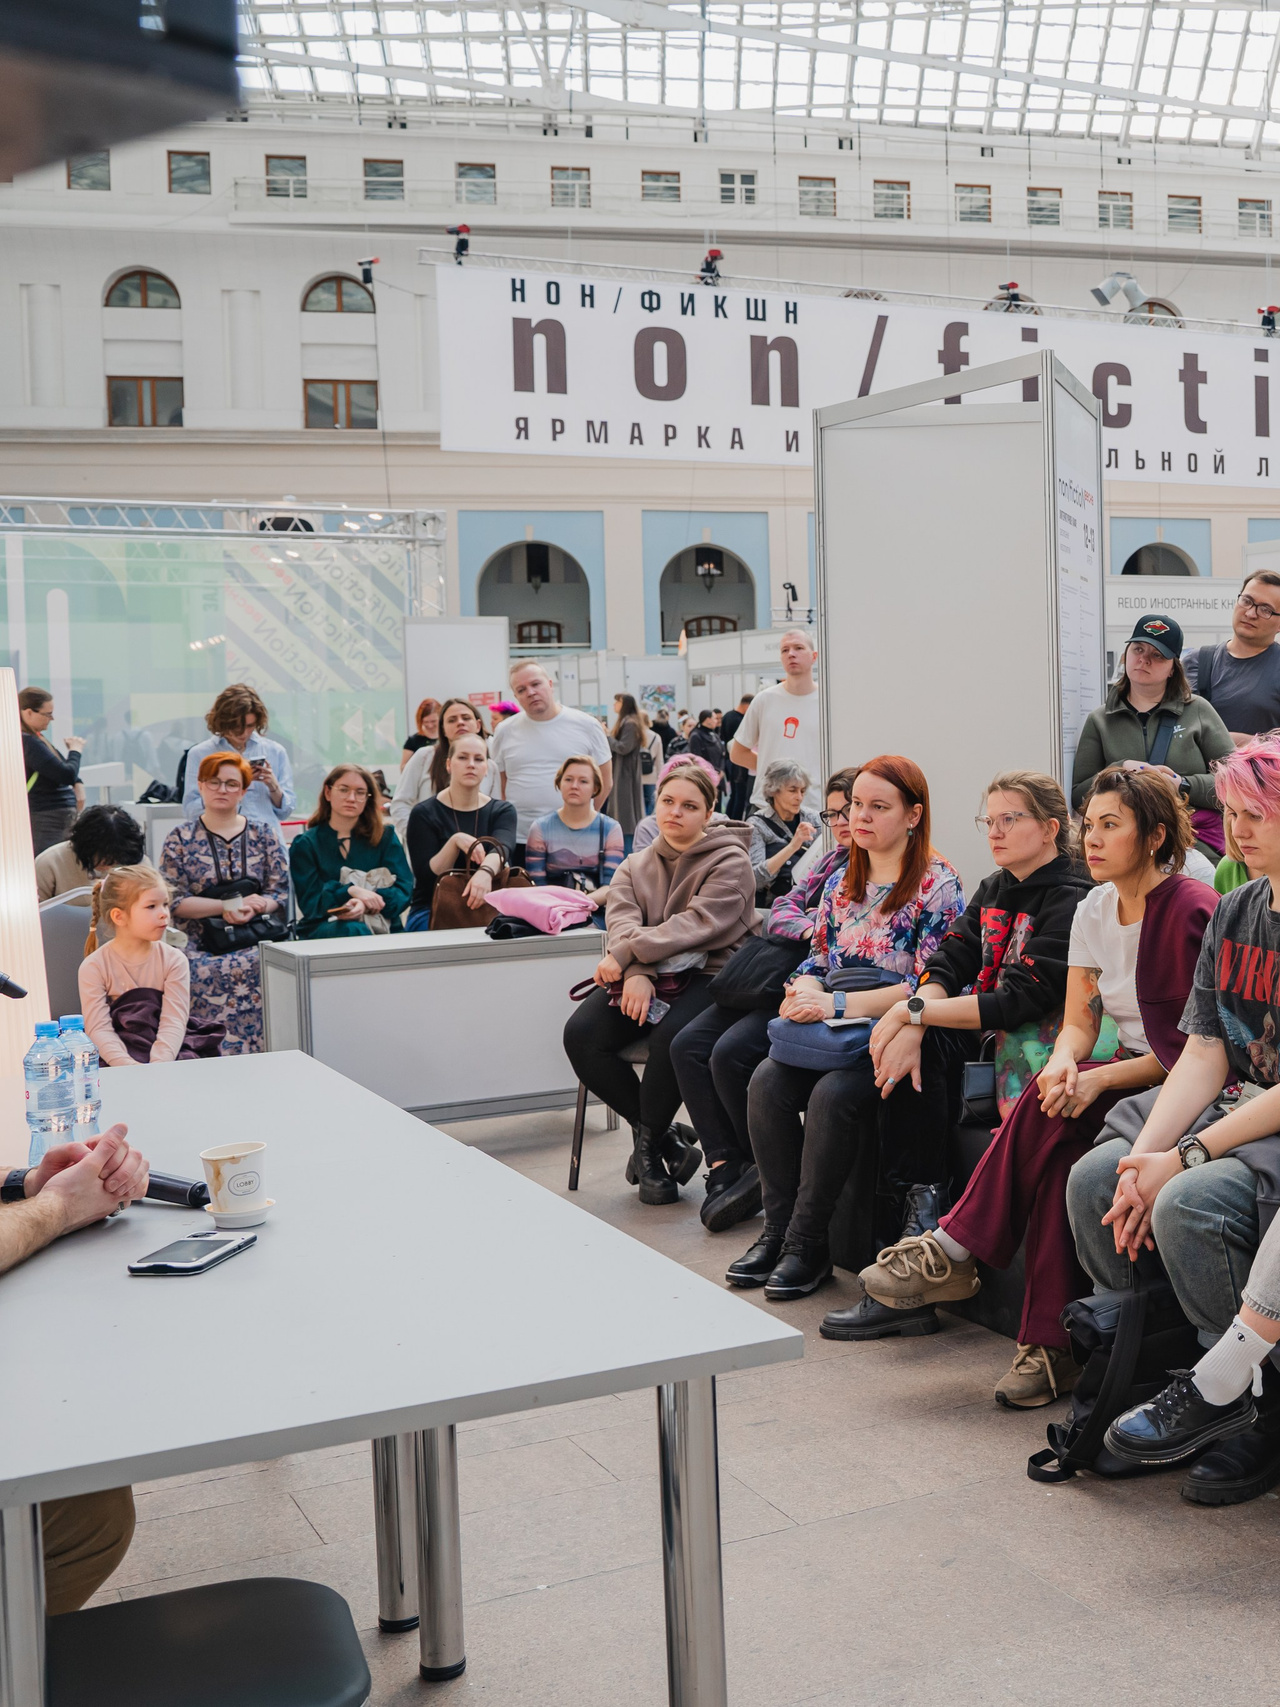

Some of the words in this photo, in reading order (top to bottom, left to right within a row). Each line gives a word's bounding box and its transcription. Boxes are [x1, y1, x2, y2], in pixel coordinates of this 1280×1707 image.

[510, 277, 799, 324] НОН/ФИКШН
[515, 416, 744, 451] ЯРМАРКА
[1105, 447, 1226, 476] ЛЬНОЙ
[1117, 597, 1147, 609] RELOD
[1150, 597, 1219, 610] ИНОСТРАННЫЕ
[236, 1180, 254, 1188] LOBBY
